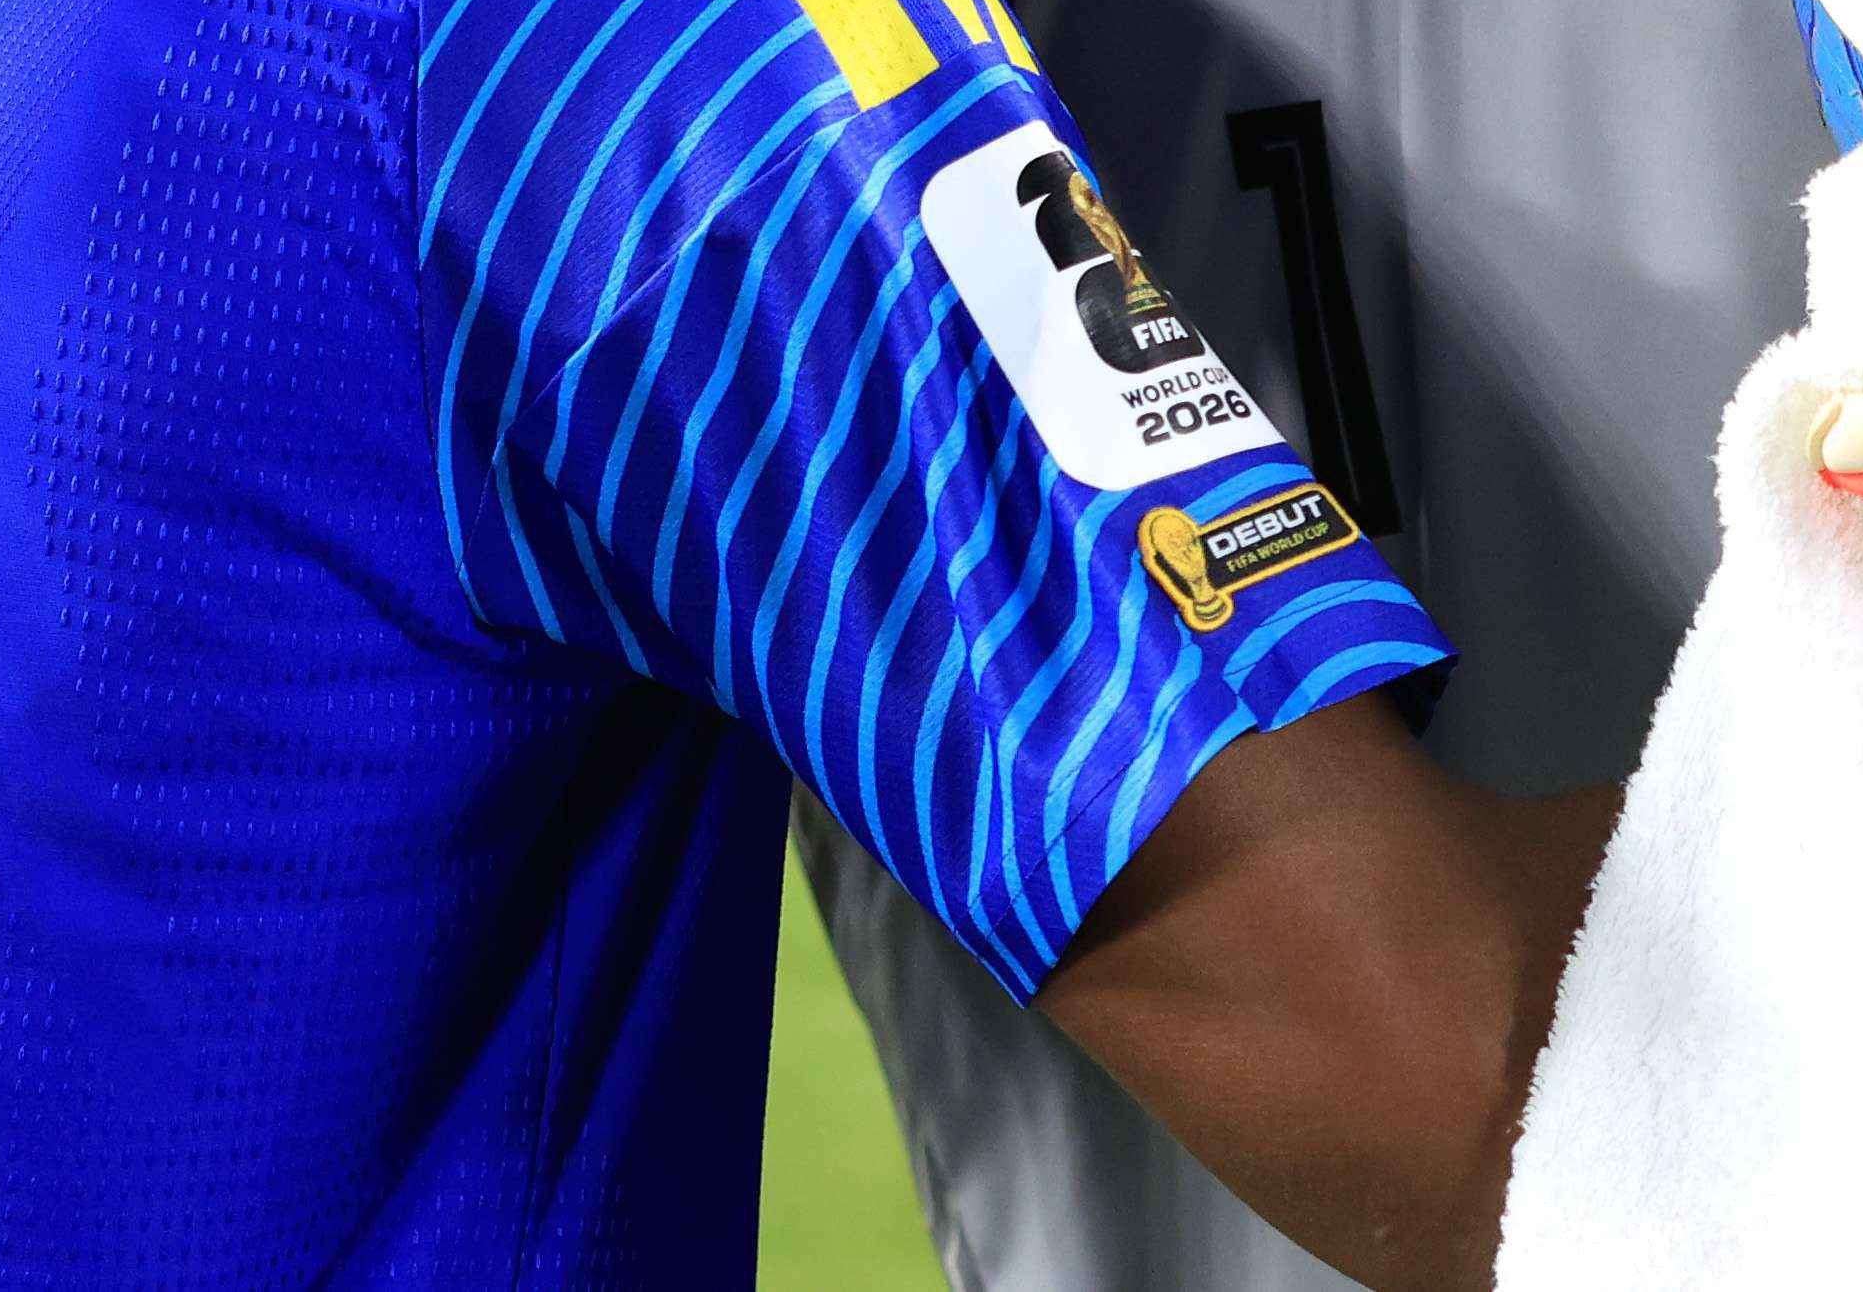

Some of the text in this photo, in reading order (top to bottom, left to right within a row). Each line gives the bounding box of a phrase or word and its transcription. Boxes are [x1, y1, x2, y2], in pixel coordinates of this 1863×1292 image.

[1131, 316, 1189, 350] FIFA
[1225, 100, 1403, 539] 1
[1120, 372, 1202, 409] WORLD
[1136, 390, 1251, 446] 2026
[1207, 494, 1323, 559] DEBUT
[1226, 521, 1329, 573] FIFA WORLD CUP
